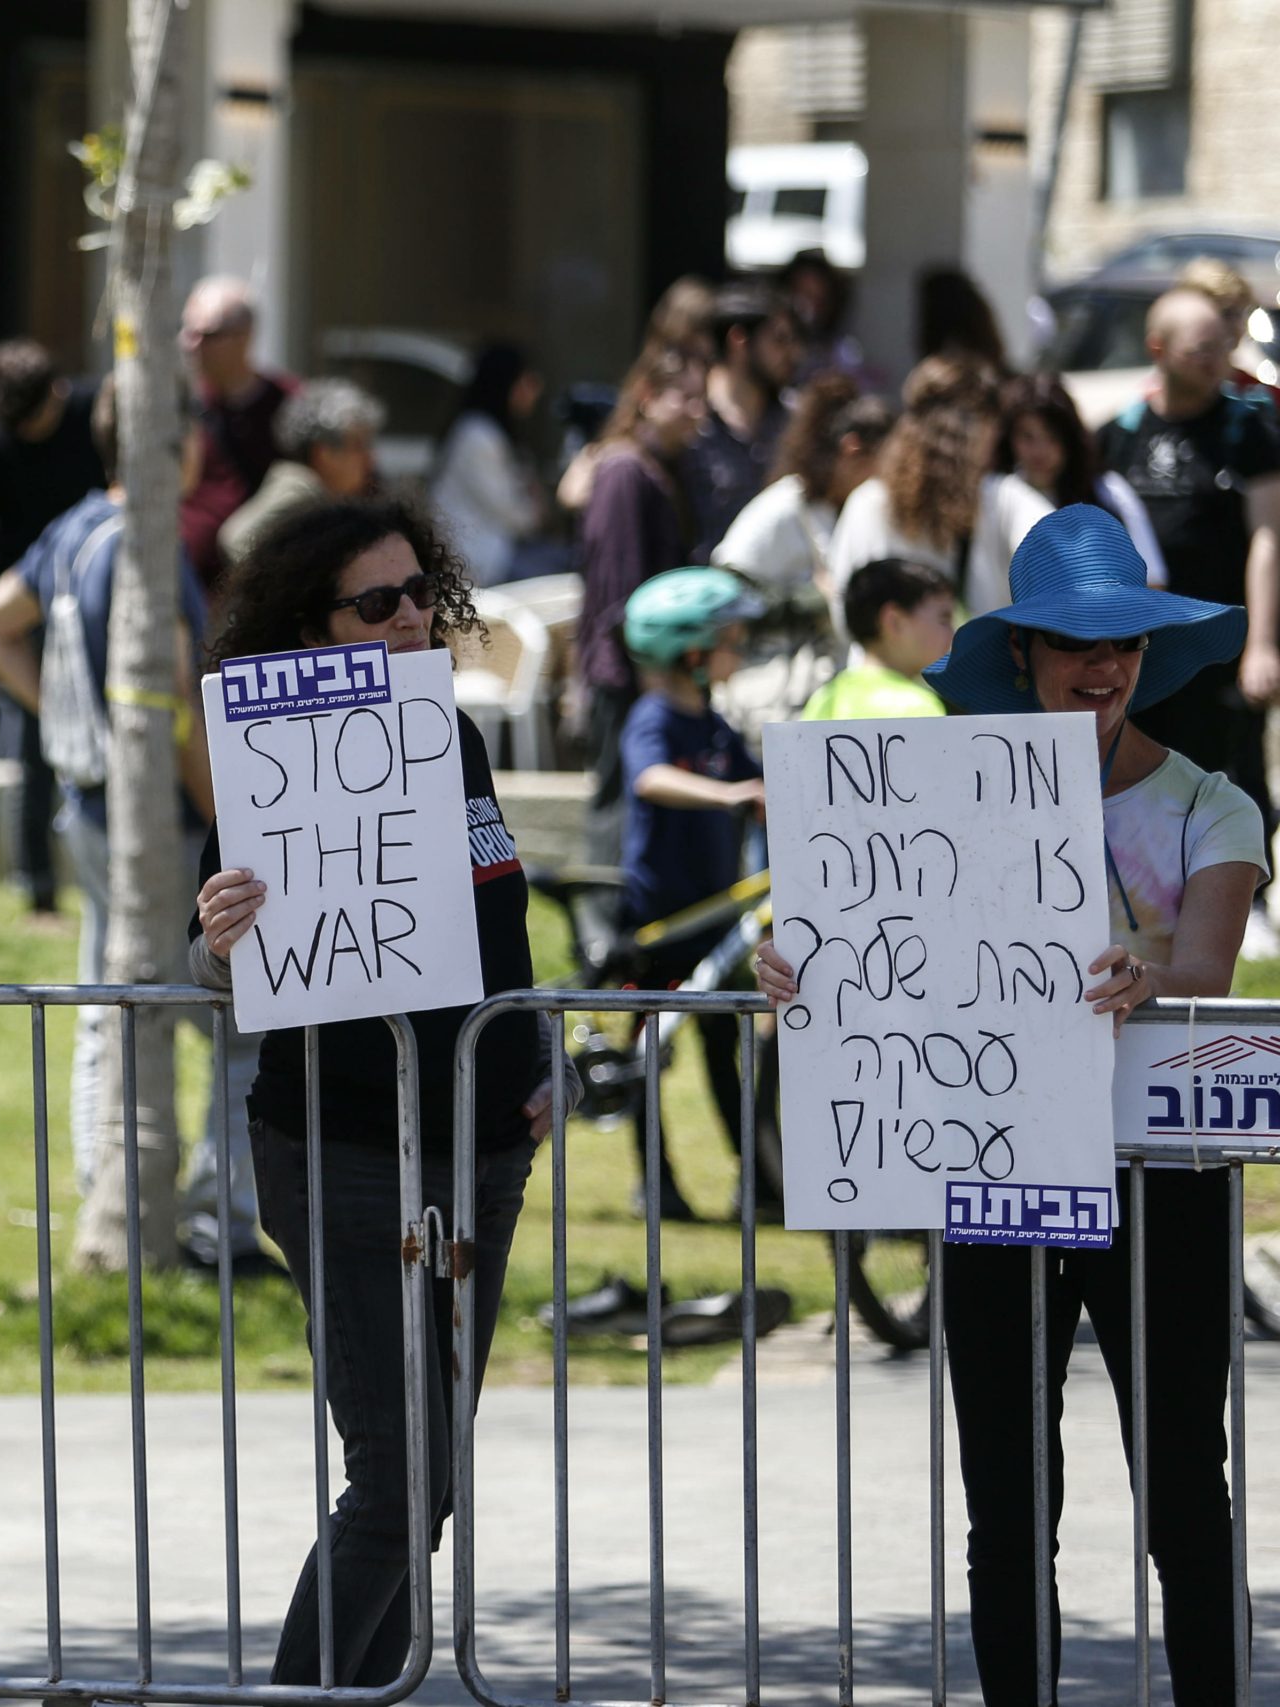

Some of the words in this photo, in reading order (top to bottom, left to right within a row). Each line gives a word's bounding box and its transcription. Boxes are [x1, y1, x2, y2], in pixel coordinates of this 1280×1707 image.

[224, 648, 387, 703] הביתה
[229, 704, 268, 715] והממשלה
[270, 701, 295, 710] חיילים
[358, 690, 388, 701] חטופים,
[243, 697, 453, 809] STOP
[825, 733, 917, 807] אם
[971, 733, 1061, 810] מה
[262, 809, 418, 896] THE
[809, 828, 959, 913] היתה
[1034, 837, 1086, 913] זו
[254, 898, 423, 996] WAR
[957, 939, 1084, 1010] הבת
[840, 1030, 1018, 1110] עסקה
[1214, 1073, 1254, 1086] ובמות
[827, 1100, 1017, 1204] עכשיו!
[950, 1185, 1109, 1231] הביתה
[950, 1227, 989, 1236] והממשלה
[991, 1229, 1016, 1237] חיילים
[1078, 1233, 1108, 1242] חטופים,
